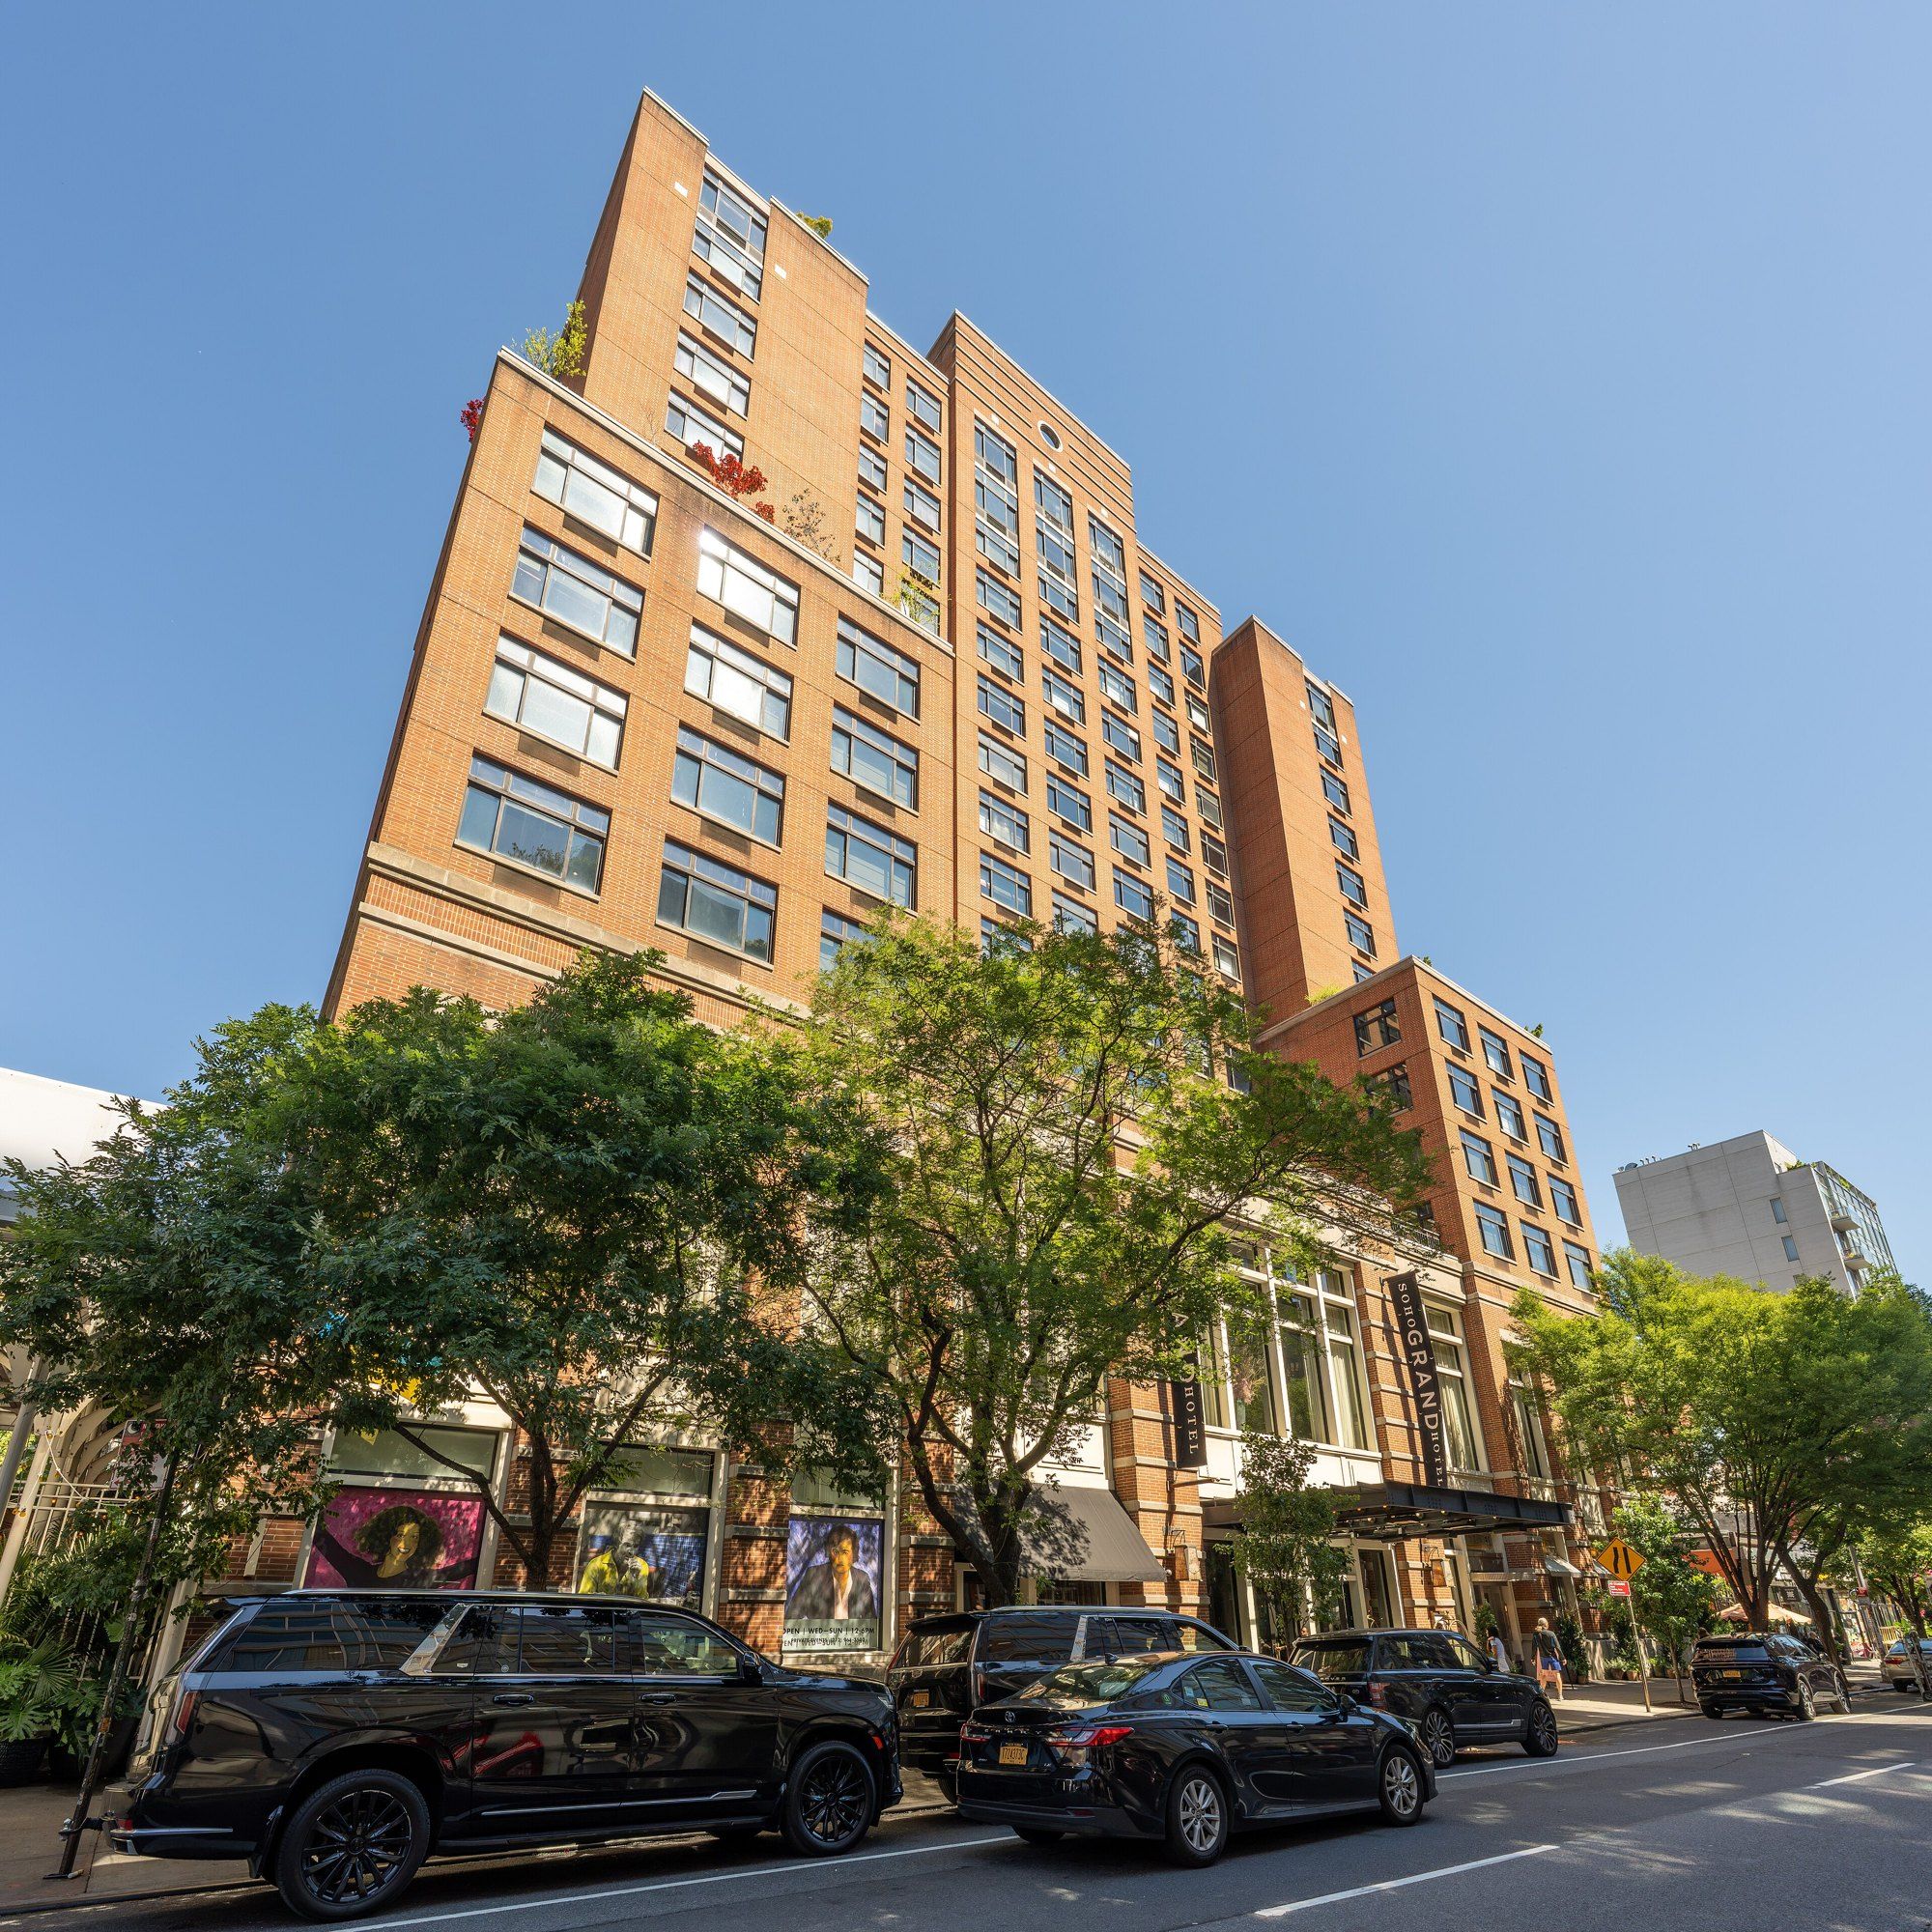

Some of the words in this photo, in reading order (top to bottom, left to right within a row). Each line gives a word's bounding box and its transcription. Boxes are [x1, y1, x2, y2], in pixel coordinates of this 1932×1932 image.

[1184, 1386, 1199, 1455] HOTEL
[1398, 1283, 1416, 1327] SOHO
[1407, 1329, 1438, 1430] GRAND
[1431, 1432, 1444, 1487] HOTEL
